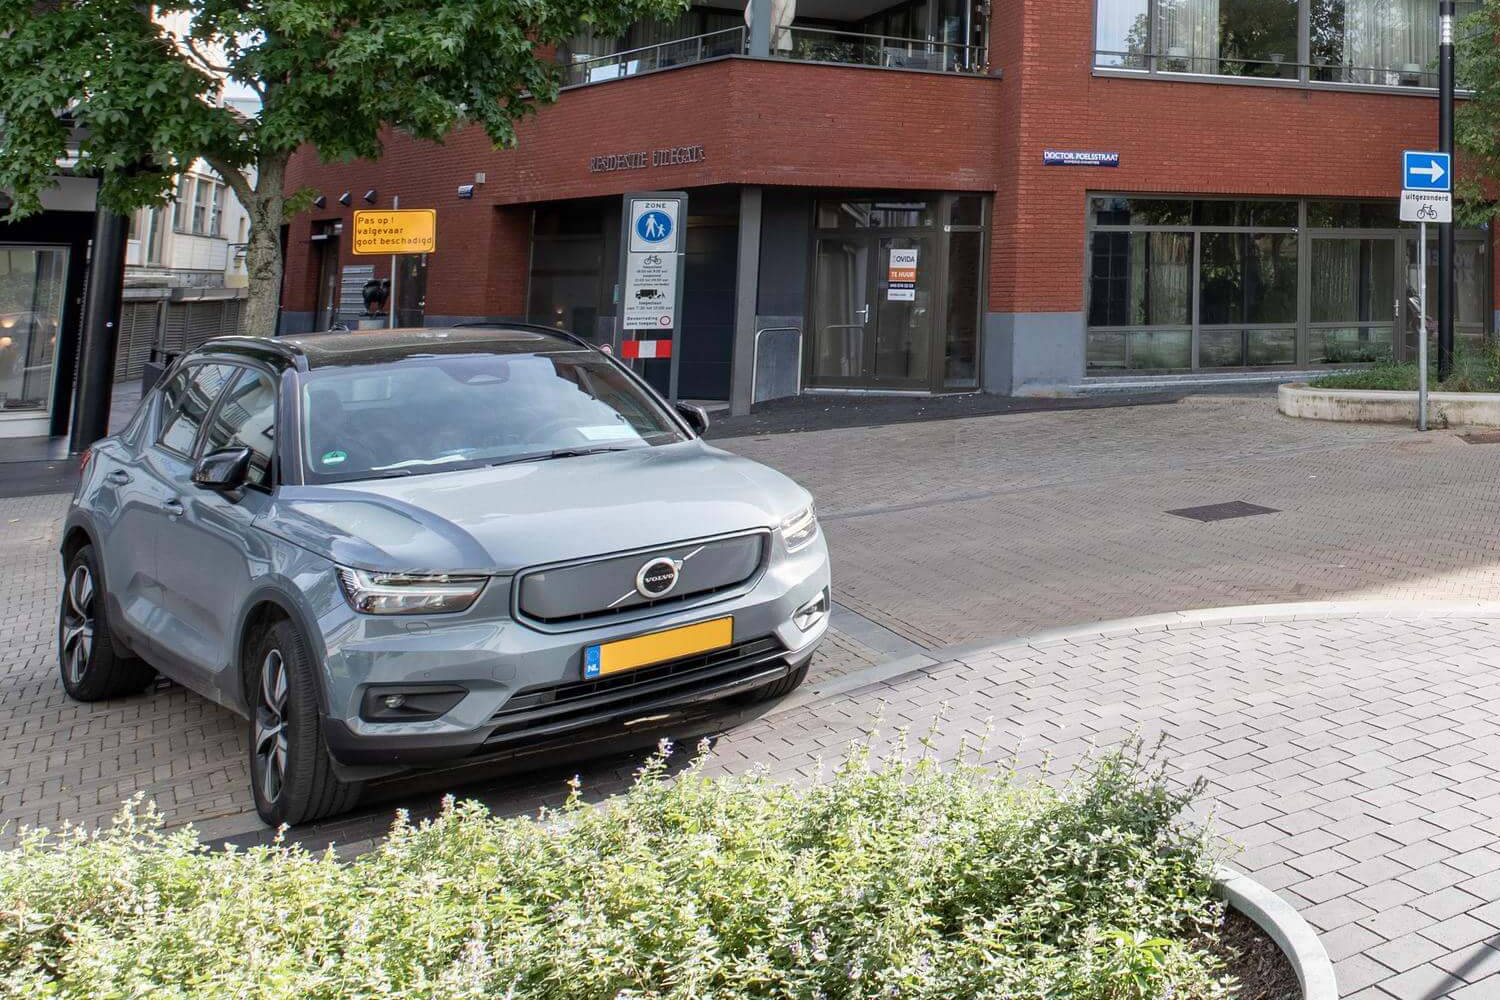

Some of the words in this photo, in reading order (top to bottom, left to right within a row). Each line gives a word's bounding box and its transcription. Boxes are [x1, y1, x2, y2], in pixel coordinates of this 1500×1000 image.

[1044, 152, 1074, 160] DOCTOR
[1405, 194, 1449, 202] uitgezonderd
[358, 217, 375, 225] Pas
[357, 228, 404, 236] valgevaar
[356, 238, 377, 247] goot
[380, 237, 432, 246] beschadigd
[645, 573, 674, 583] VOLVO
[587, 663, 599, 673] NL
